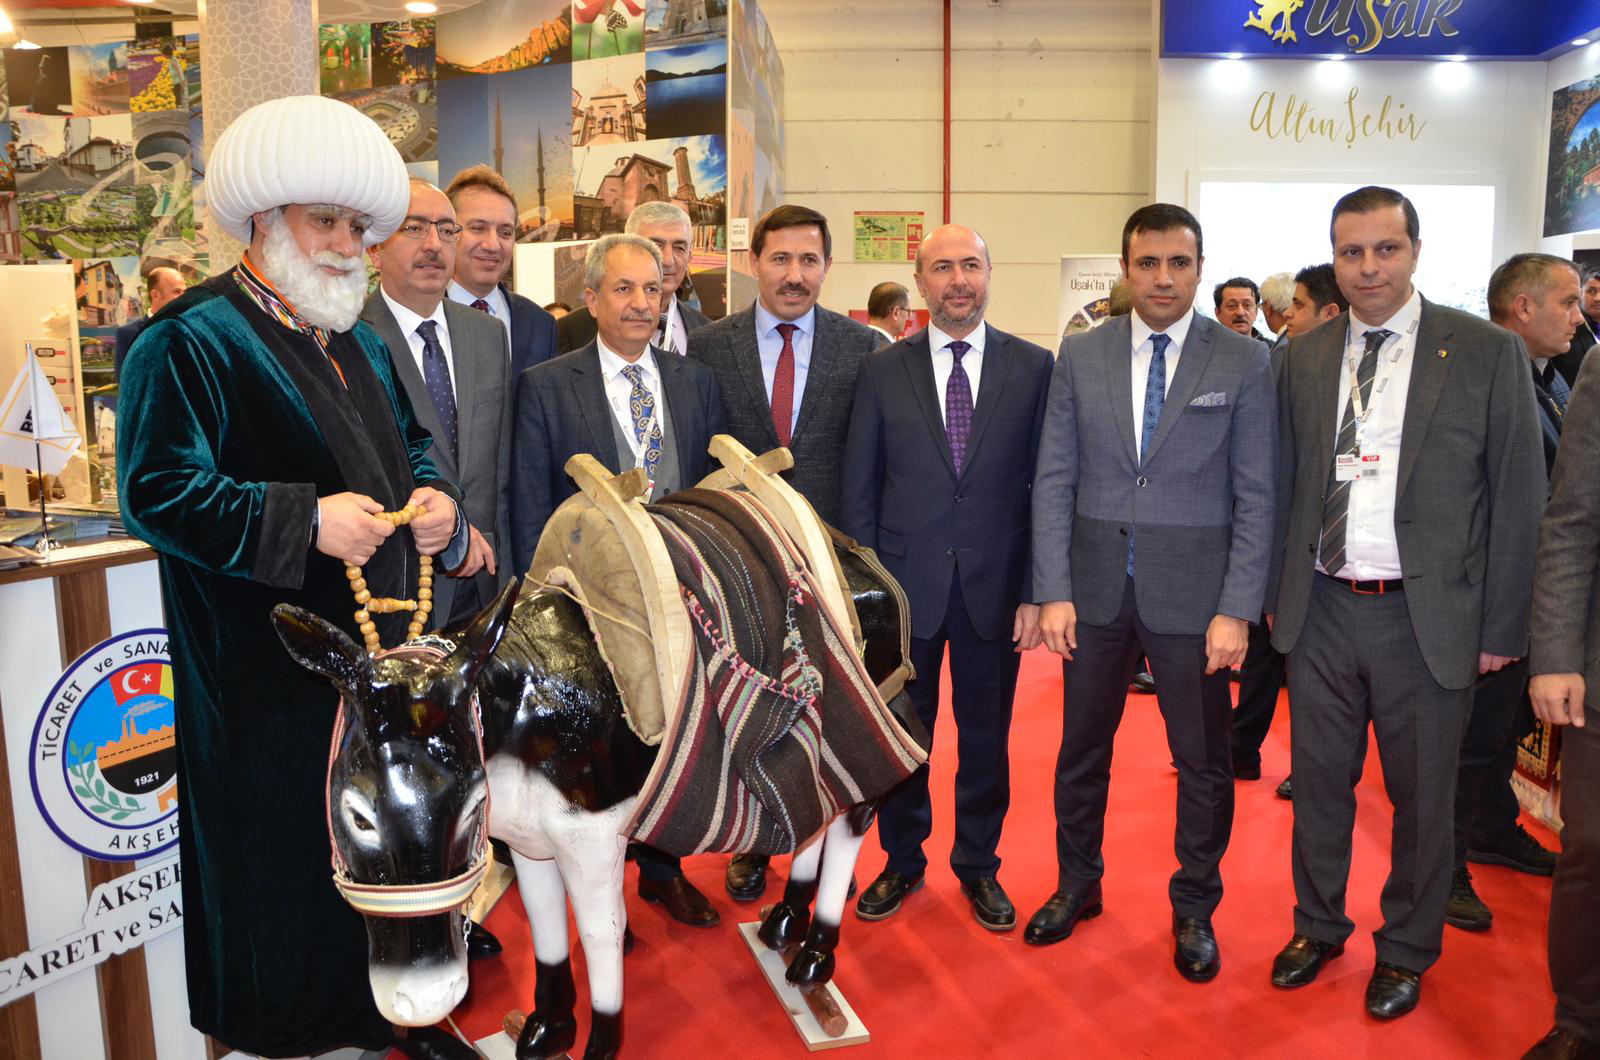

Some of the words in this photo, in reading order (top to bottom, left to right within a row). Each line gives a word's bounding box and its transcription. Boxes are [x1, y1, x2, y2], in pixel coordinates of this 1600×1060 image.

[39, 680, 83, 761] TİCARET
[93, 656, 114, 674] ve
[123, 640, 172, 659] SANA
[133, 771, 160, 787] 1921
[108, 819, 180, 850] AKŞEH
[0, 929, 105, 994] CARET
[113, 921, 142, 943] ve
[148, 900, 184, 930] SA
